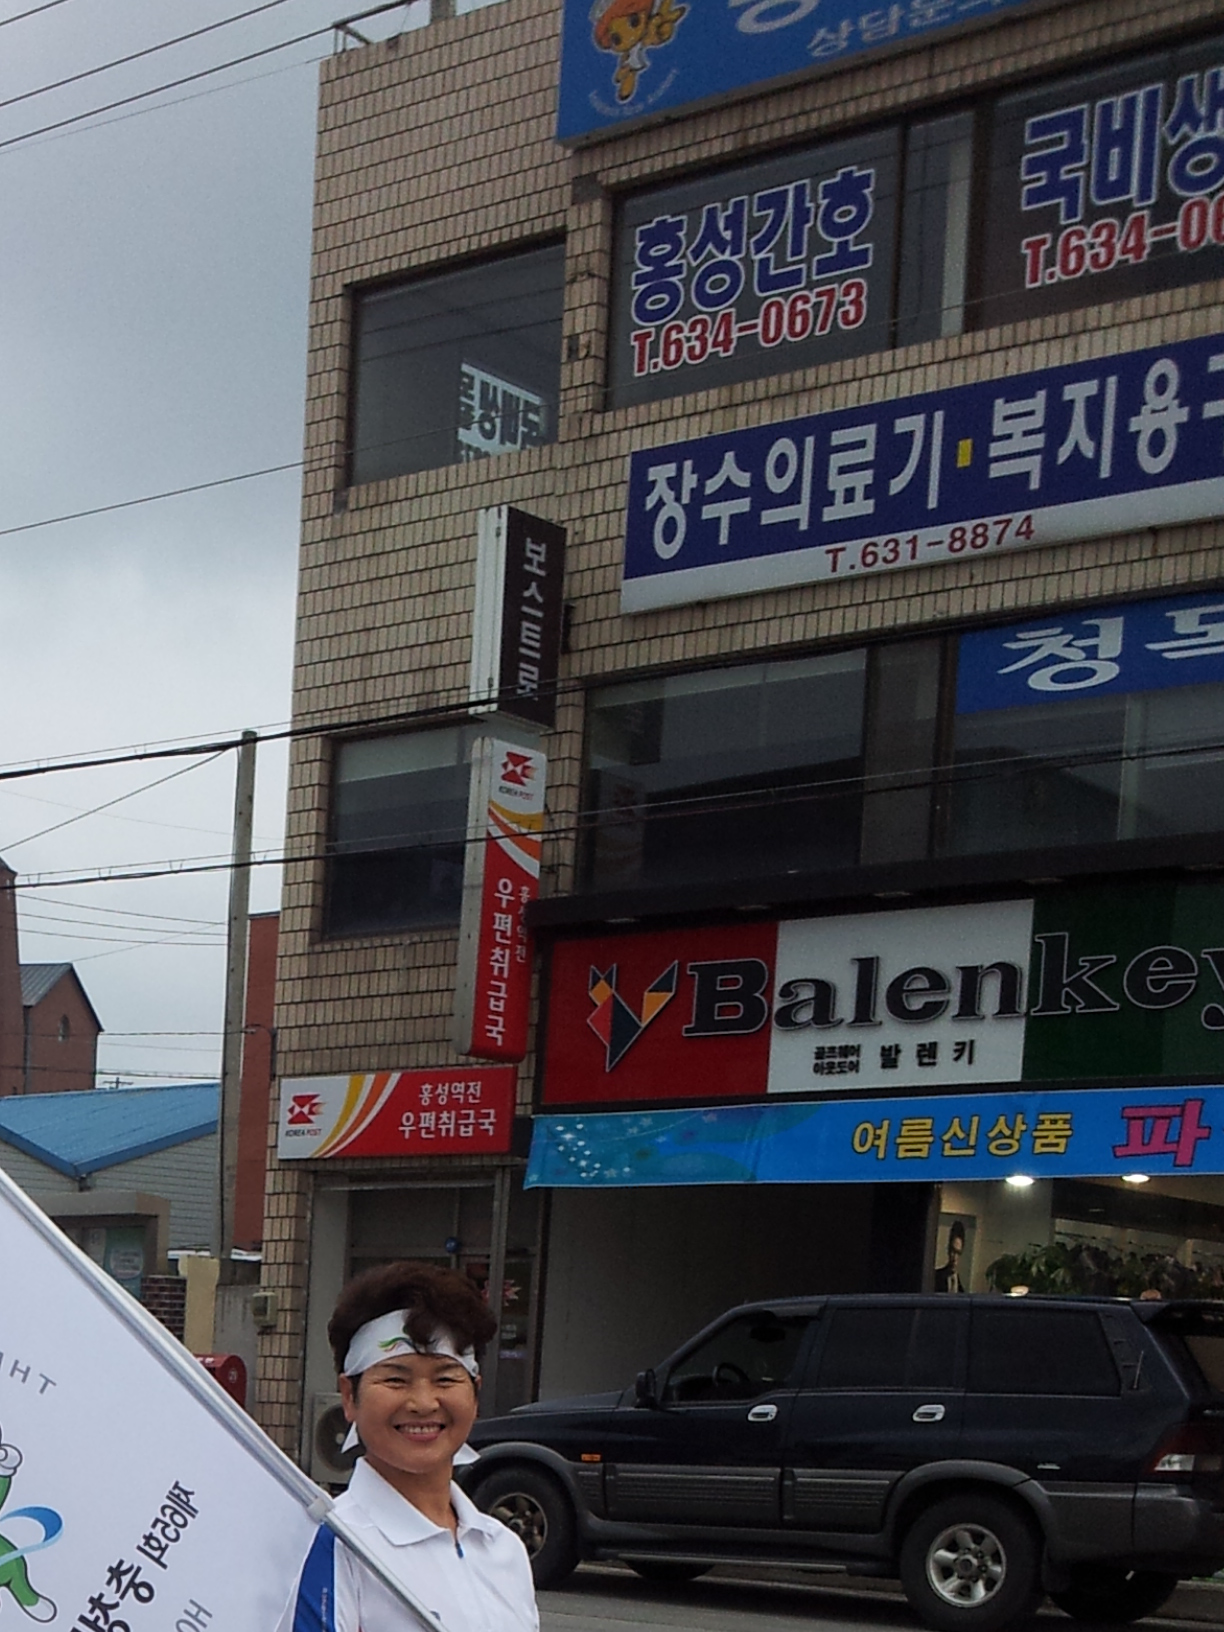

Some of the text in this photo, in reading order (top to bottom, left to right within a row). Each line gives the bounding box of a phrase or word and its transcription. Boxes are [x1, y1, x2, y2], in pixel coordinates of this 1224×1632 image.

[631, 166, 875, 326] 홍성간호
[631, 278, 867, 376] T.634-0673
[825, 514, 1035, 573] T.631-8874
[485, 877, 515, 1046] 우편취급국
[418, 1081, 482, 1106] 홍성역전
[398, 1108, 497, 1139] 우편취급국
[851, 1111, 1074, 1160] 여름신상품
